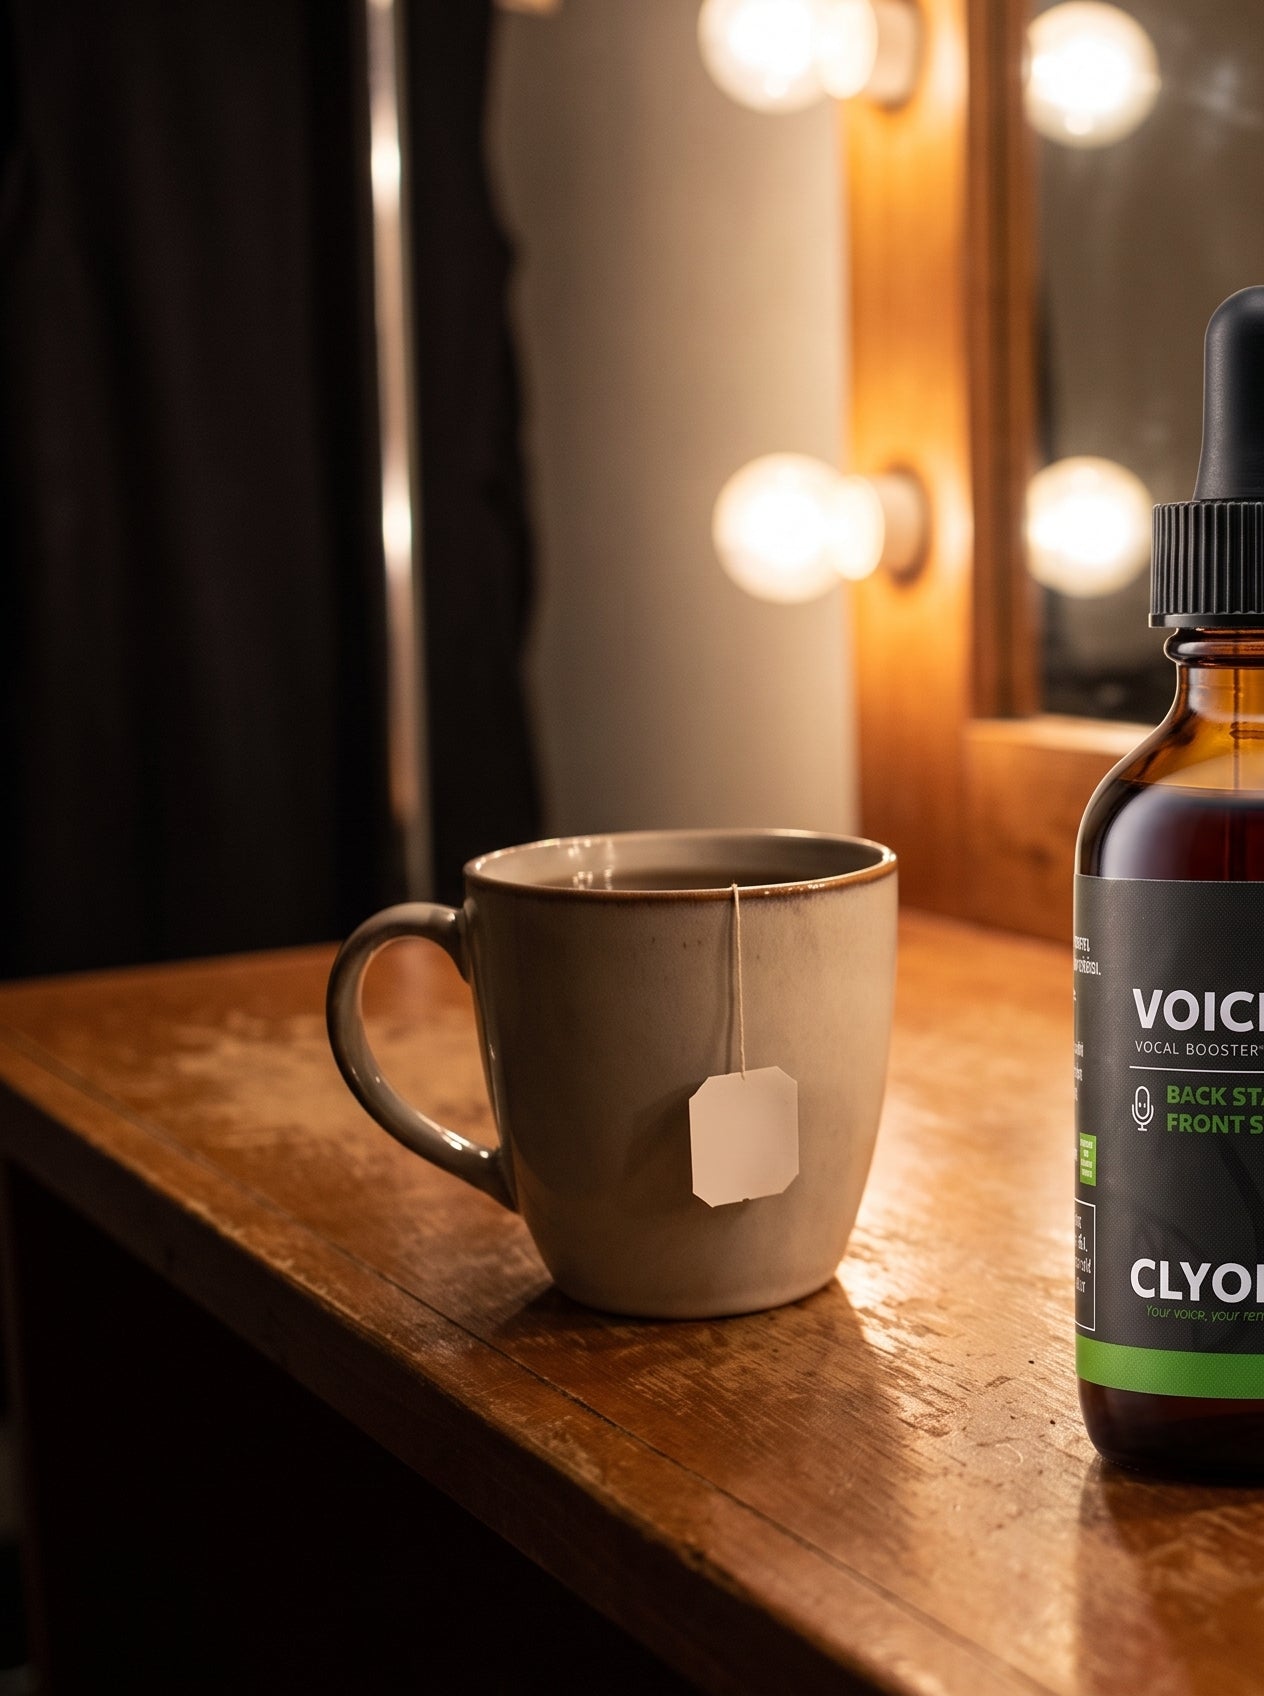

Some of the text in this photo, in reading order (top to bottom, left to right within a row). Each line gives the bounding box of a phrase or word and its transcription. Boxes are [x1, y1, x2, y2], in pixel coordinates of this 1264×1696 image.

[1135, 1040, 1179, 1055] VOCAL
[1186, 1043, 1259, 1056] BOOSTER
[1167, 1085, 1227, 1105] BACK
[1167, 1113, 1245, 1133] FRONT
[1145, 1304, 1171, 1318] Your
[1211, 1310, 1239, 1323] your
